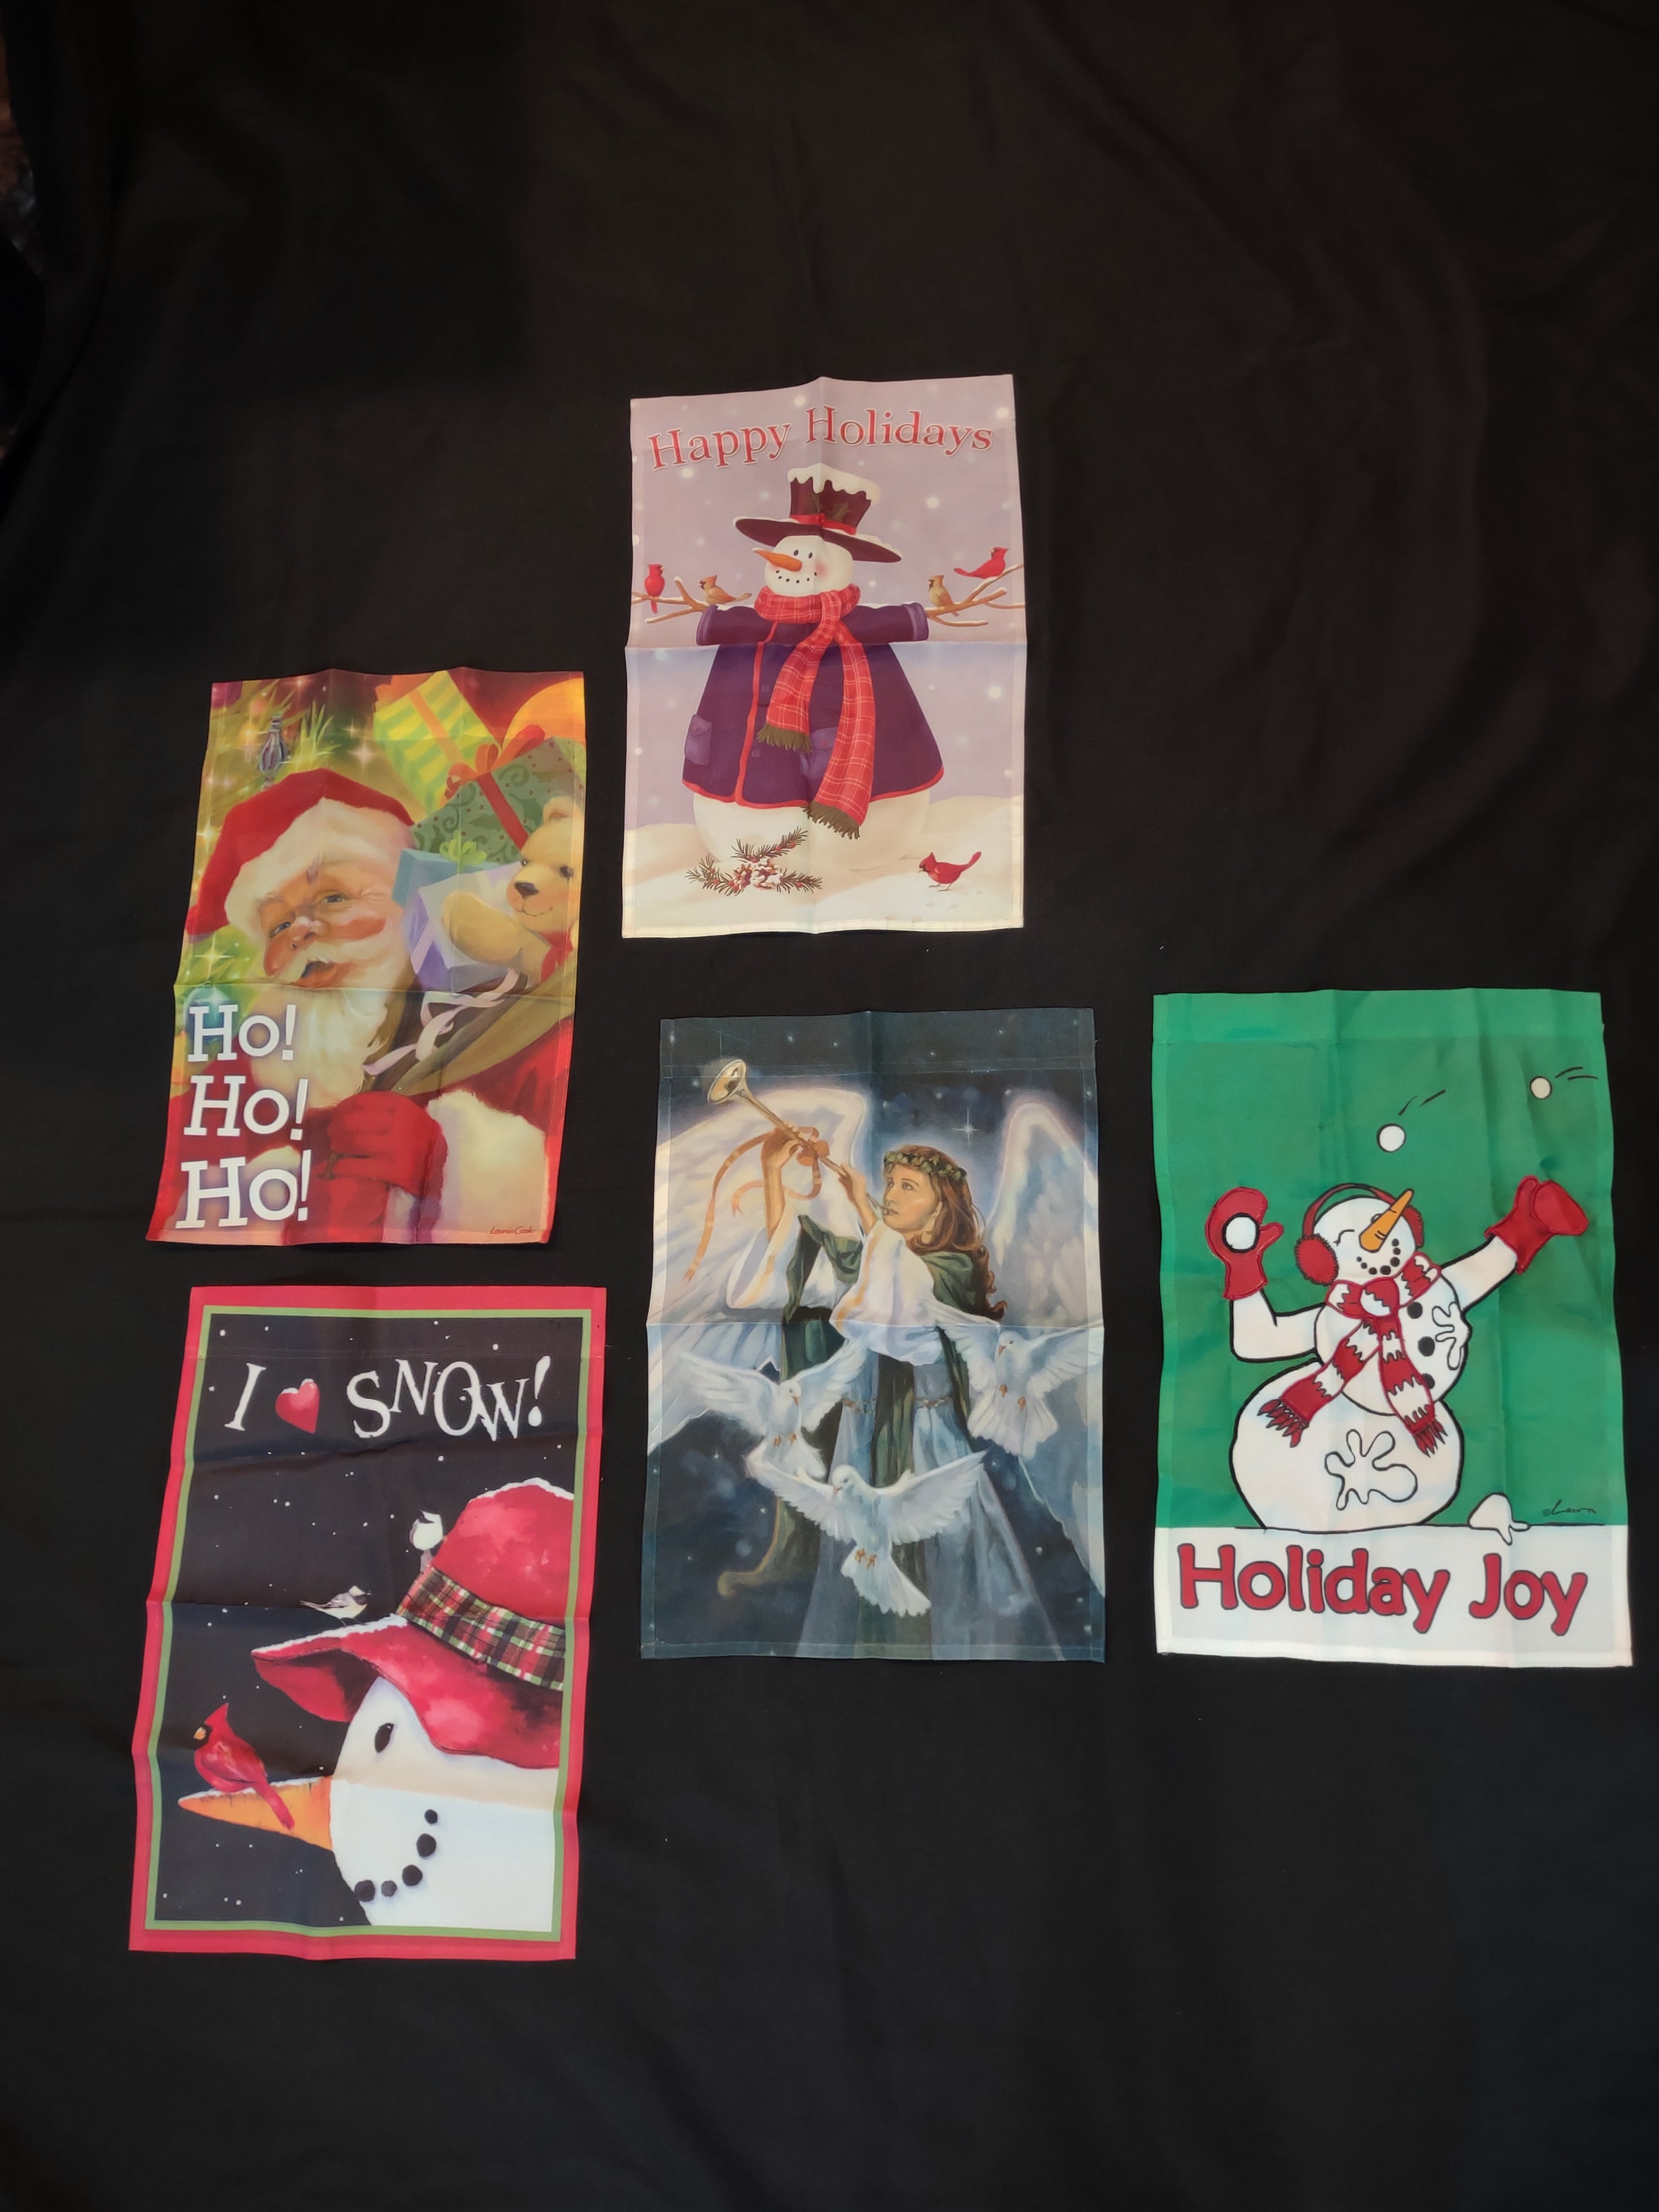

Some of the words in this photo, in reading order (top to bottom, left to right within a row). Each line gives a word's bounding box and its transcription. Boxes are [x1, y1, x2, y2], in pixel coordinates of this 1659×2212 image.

[646, 423, 791, 470] Happy
[805, 405, 993, 457] Holidays
[224, 1362, 267, 1432] I
[346, 1355, 551, 1442] SNOW!
[1177, 1542, 1451, 1634] Holiday
[1468, 1552, 1588, 1637] Joy
